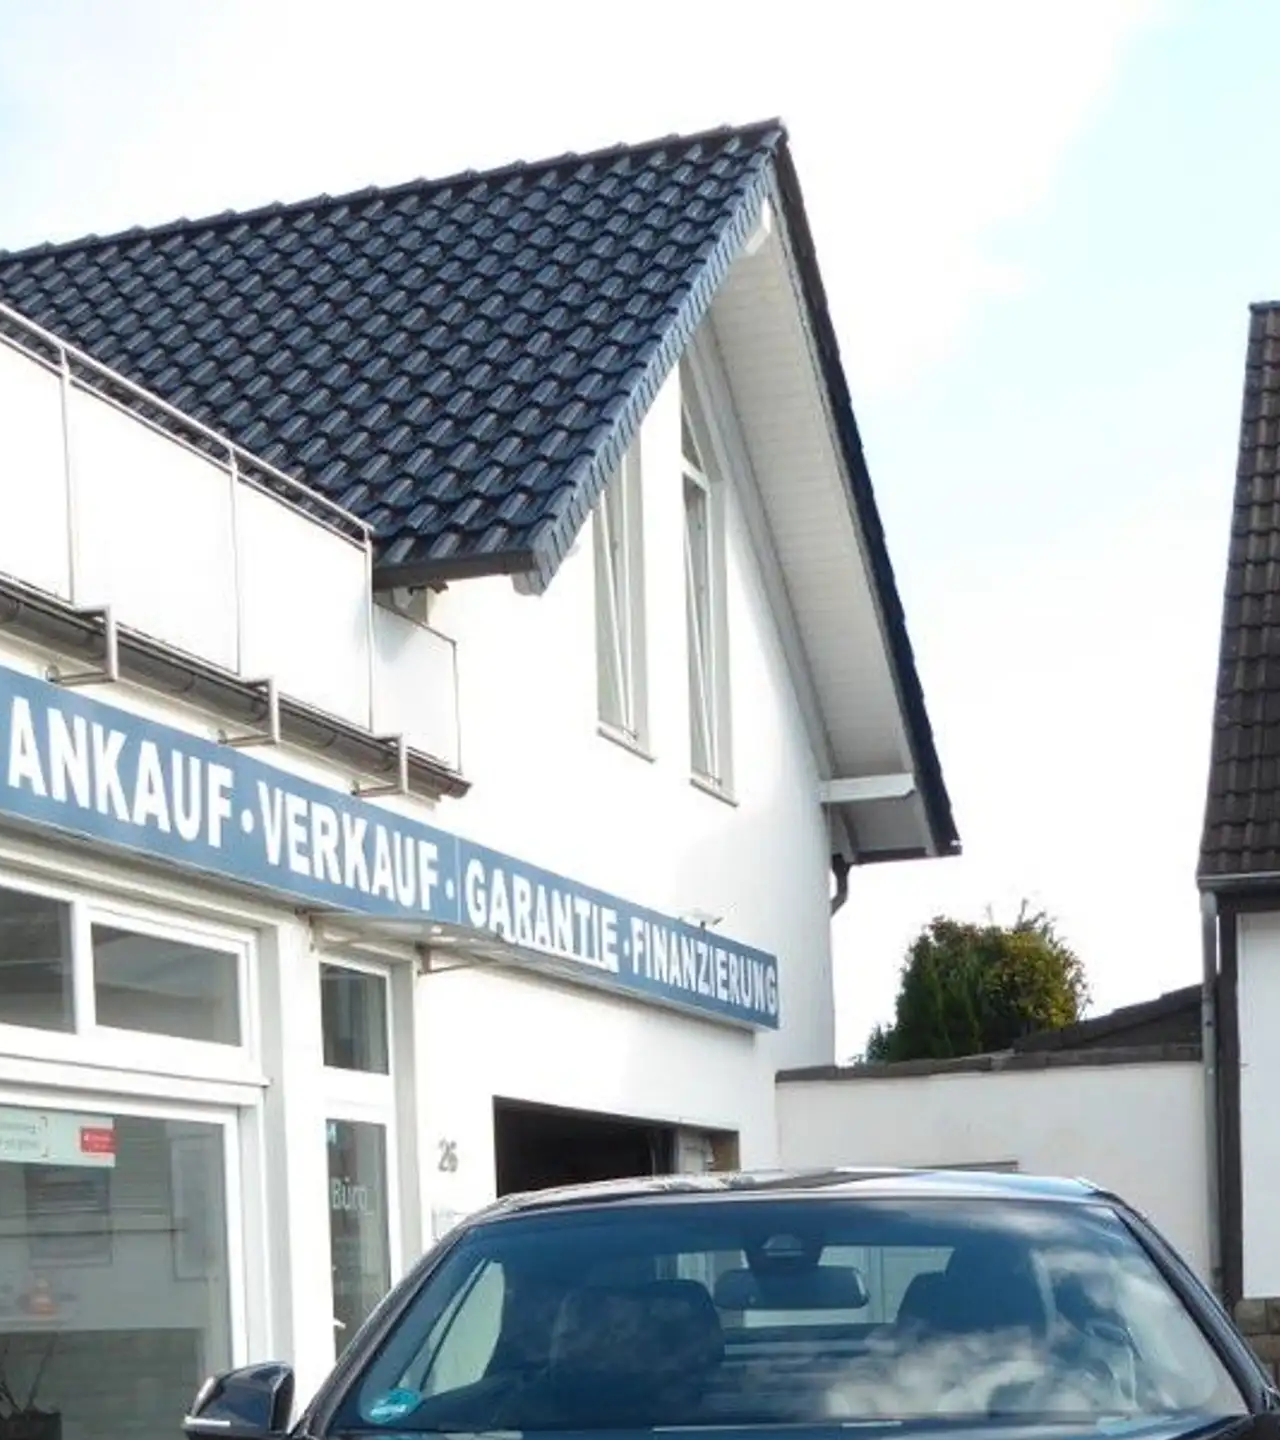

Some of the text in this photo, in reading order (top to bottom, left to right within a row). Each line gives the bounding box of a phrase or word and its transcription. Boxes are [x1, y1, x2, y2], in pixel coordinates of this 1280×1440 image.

[8, 696, 234, 848] ANKAUF
[257, 780, 438, 912] VERKAUF
[465, 859, 620, 973] GARANTIE
[631, 916, 778, 1015] FINANZIERUNG
[437, 1140, 459, 1173] 26
